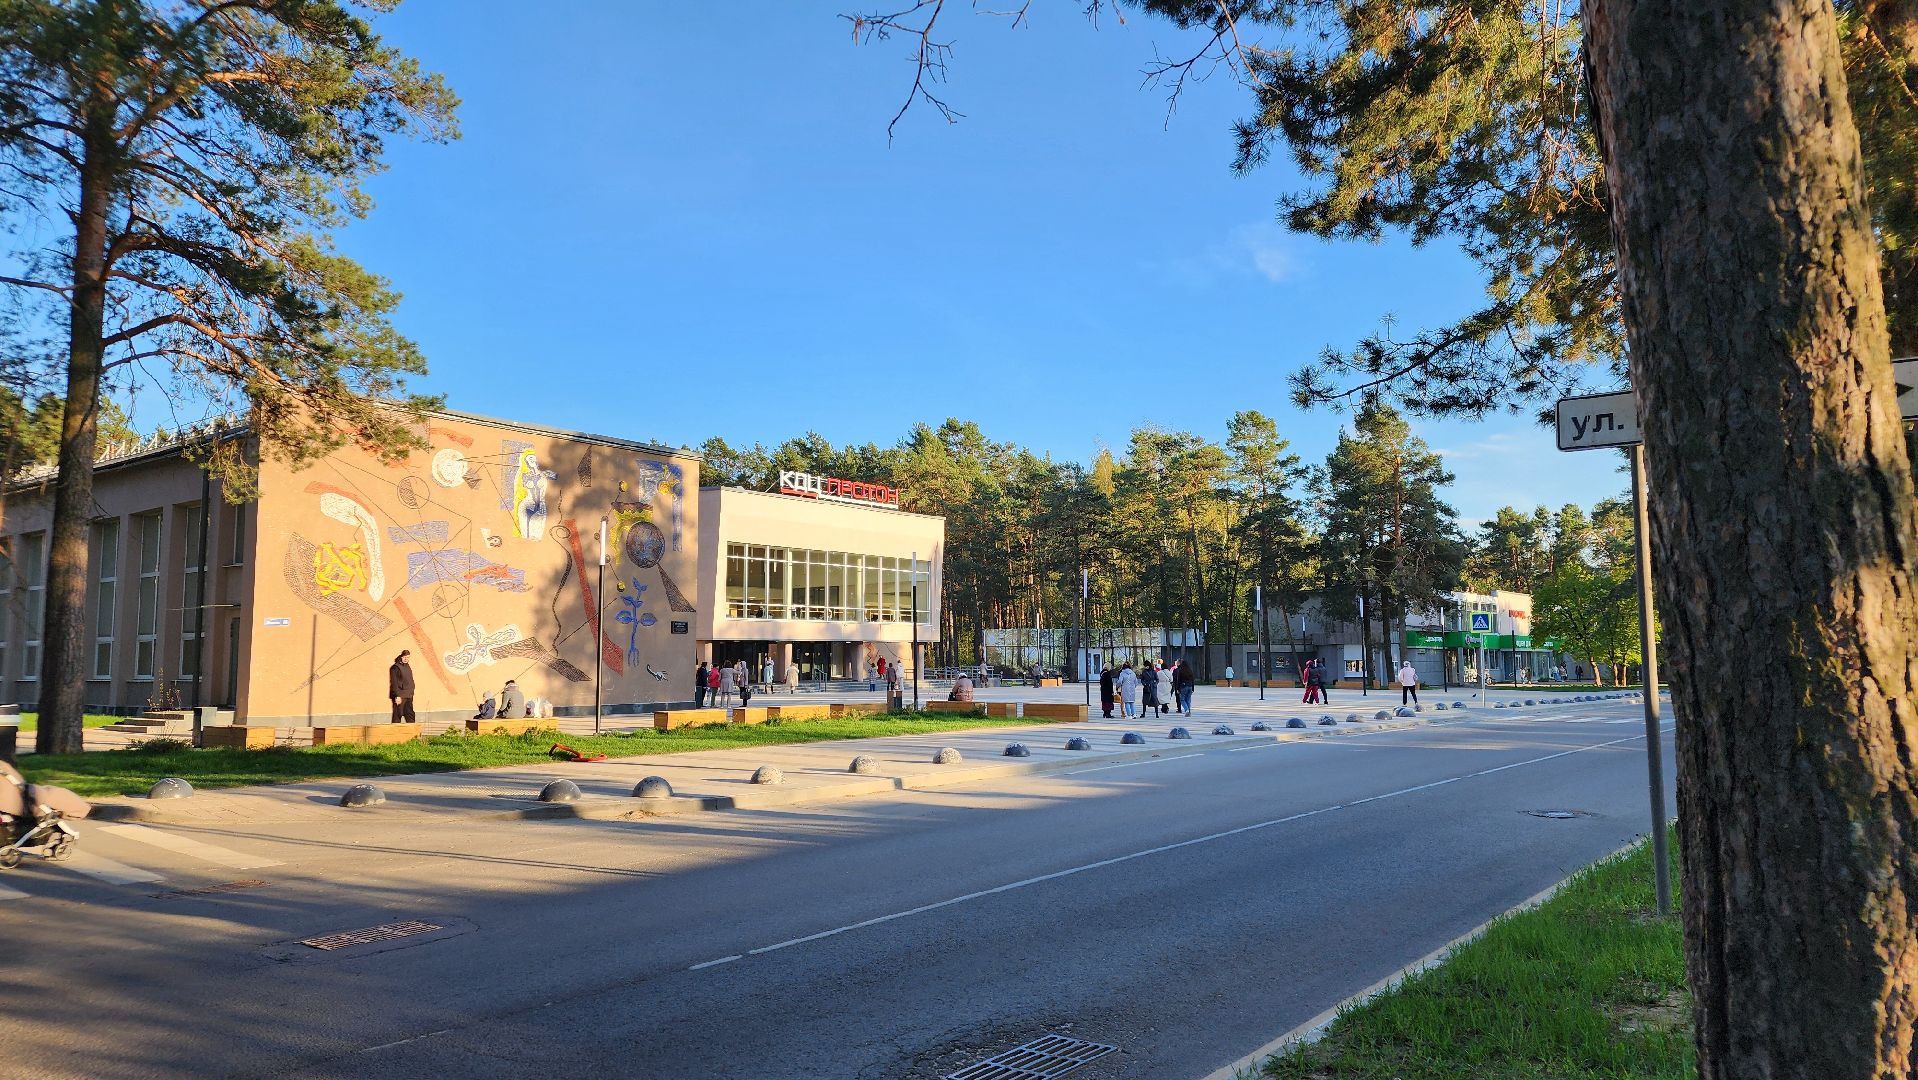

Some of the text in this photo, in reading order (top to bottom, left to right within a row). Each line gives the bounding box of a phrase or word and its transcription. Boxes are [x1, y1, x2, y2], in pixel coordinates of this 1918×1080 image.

[1571, 413, 1624, 441] ул.
[780, 470, 898, 505] КДЦ ПРОТОН
